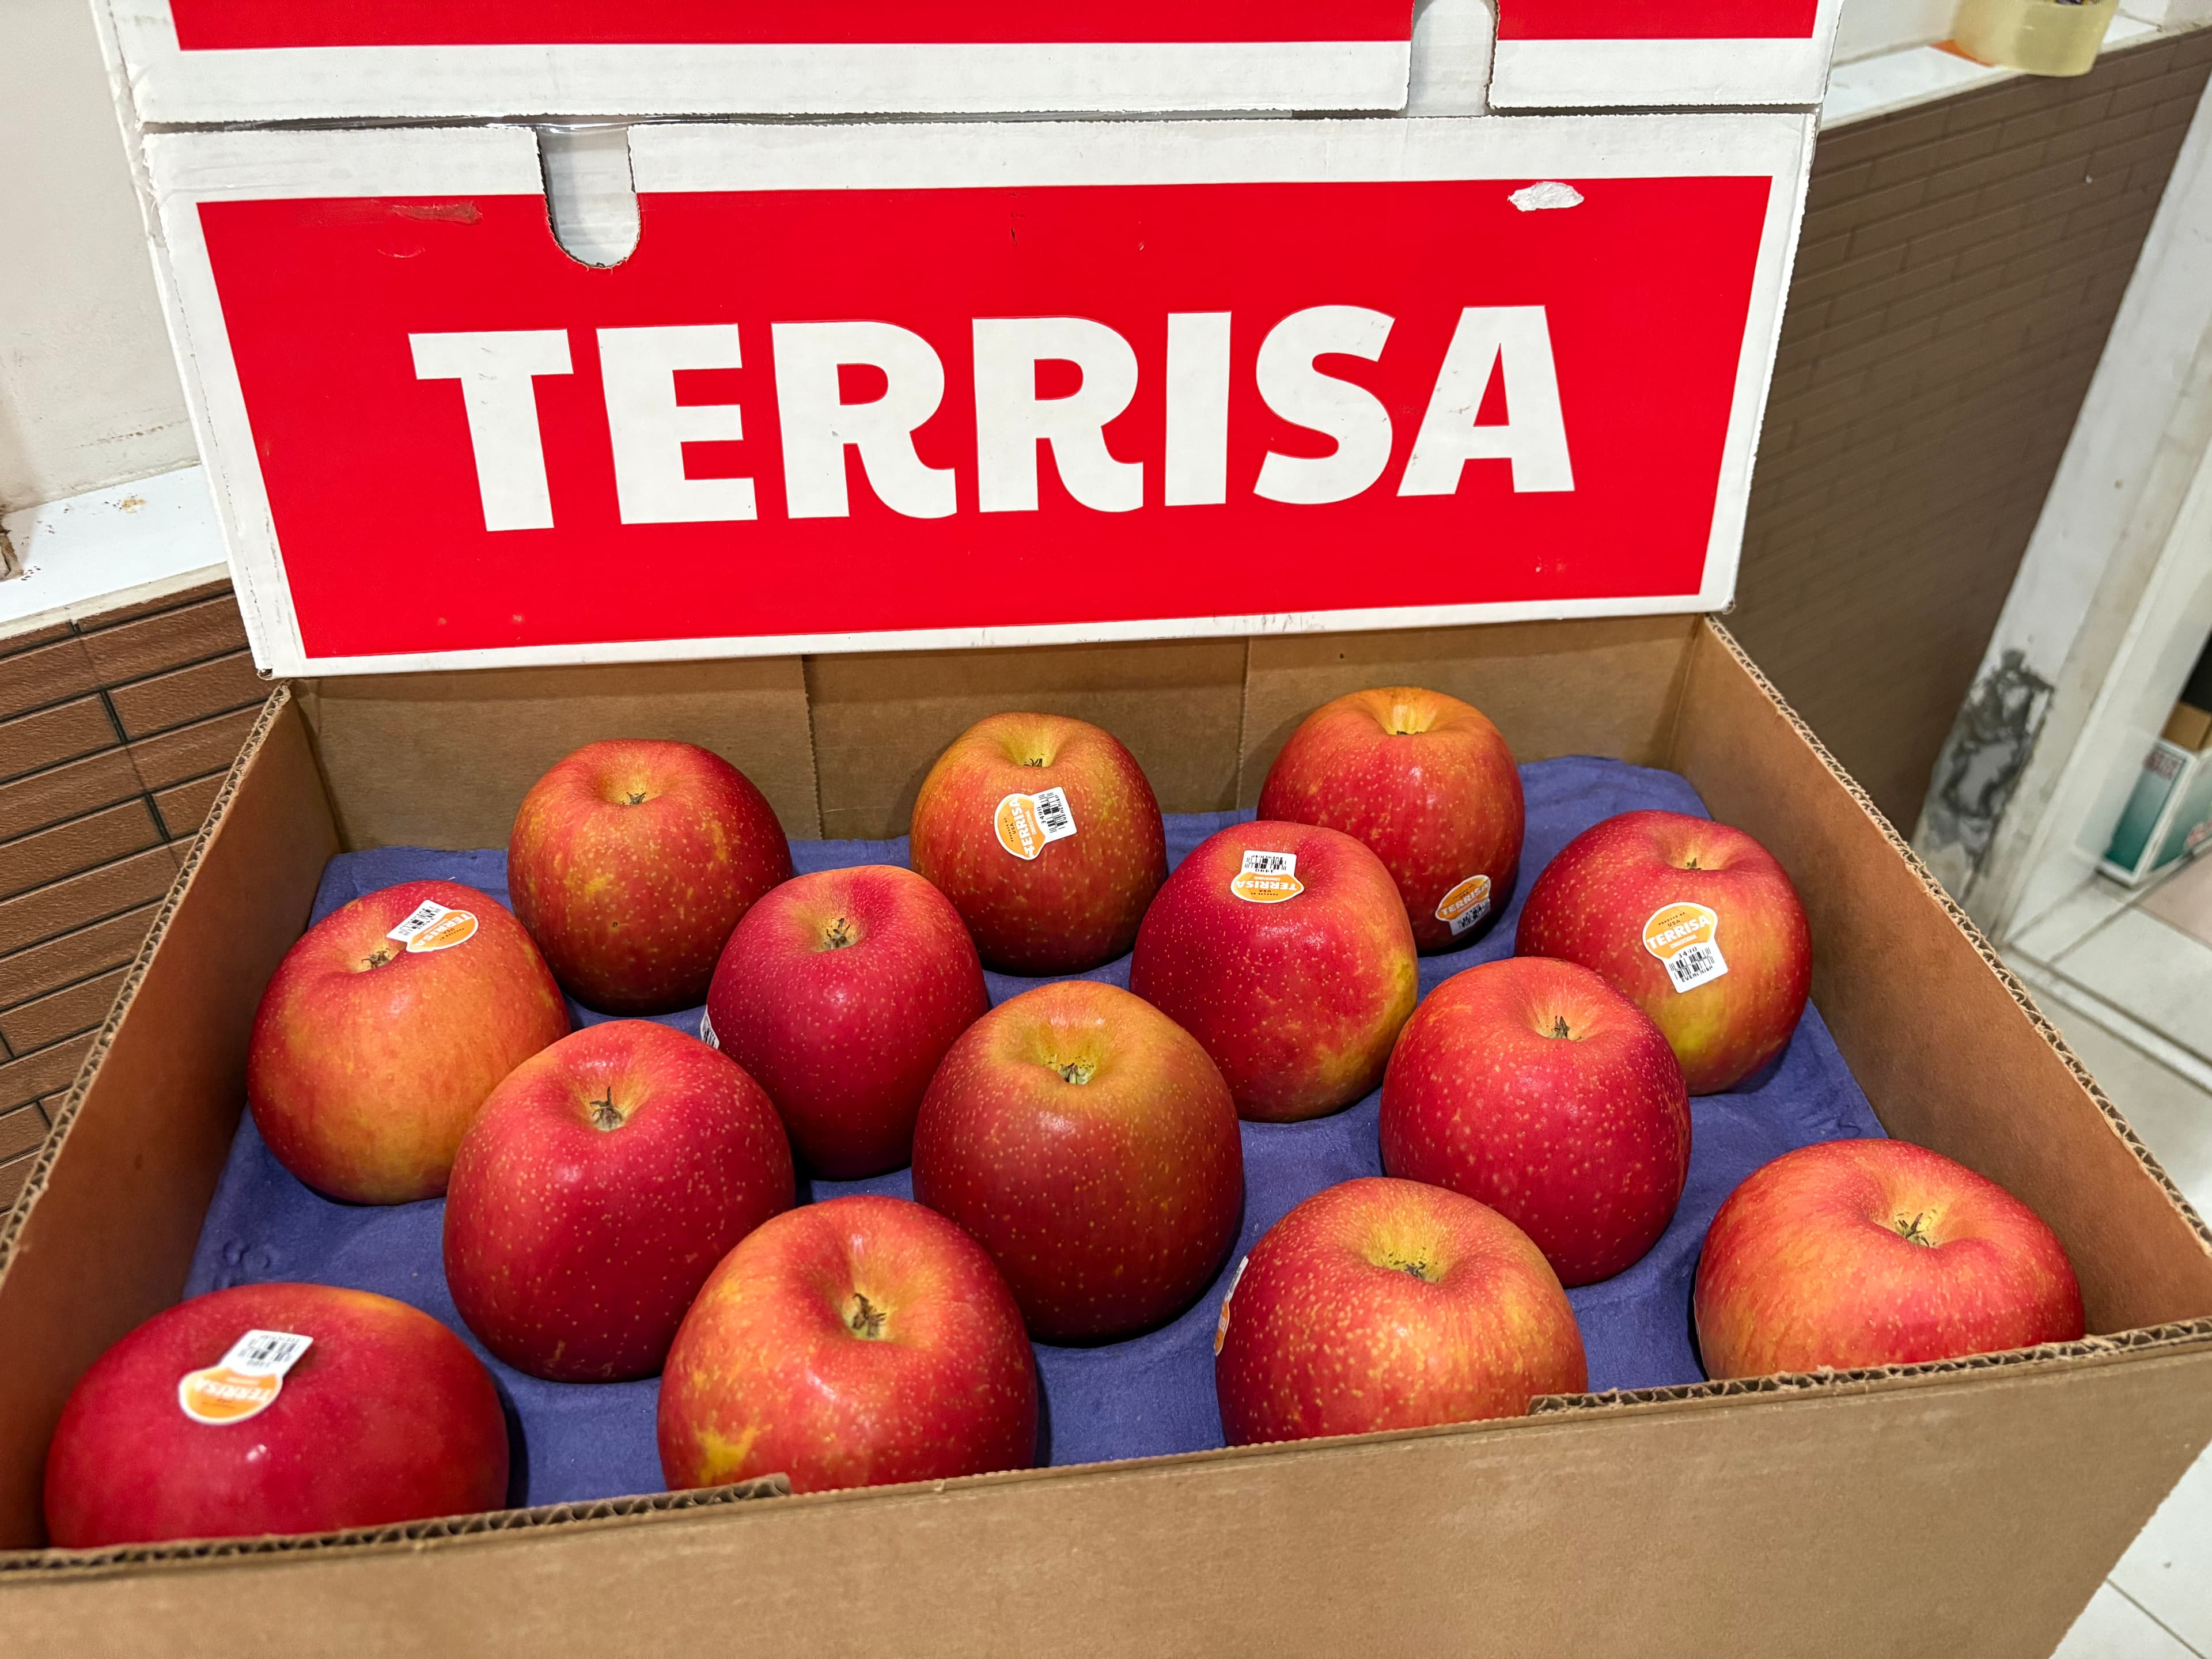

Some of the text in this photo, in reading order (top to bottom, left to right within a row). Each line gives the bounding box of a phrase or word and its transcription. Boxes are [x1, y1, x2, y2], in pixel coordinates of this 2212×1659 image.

[408, 304, 1575, 531] TERRISA
[1009, 797, 1036, 857] TERRISA
[1236, 880, 1297, 891] TERRISA
[1441, 882, 1489, 916] TERRISA
[414, 913, 473, 946] TERRISA
[1646, 915, 1711, 949] TERRISA
[194, 1377, 271, 1402] TERRISA
